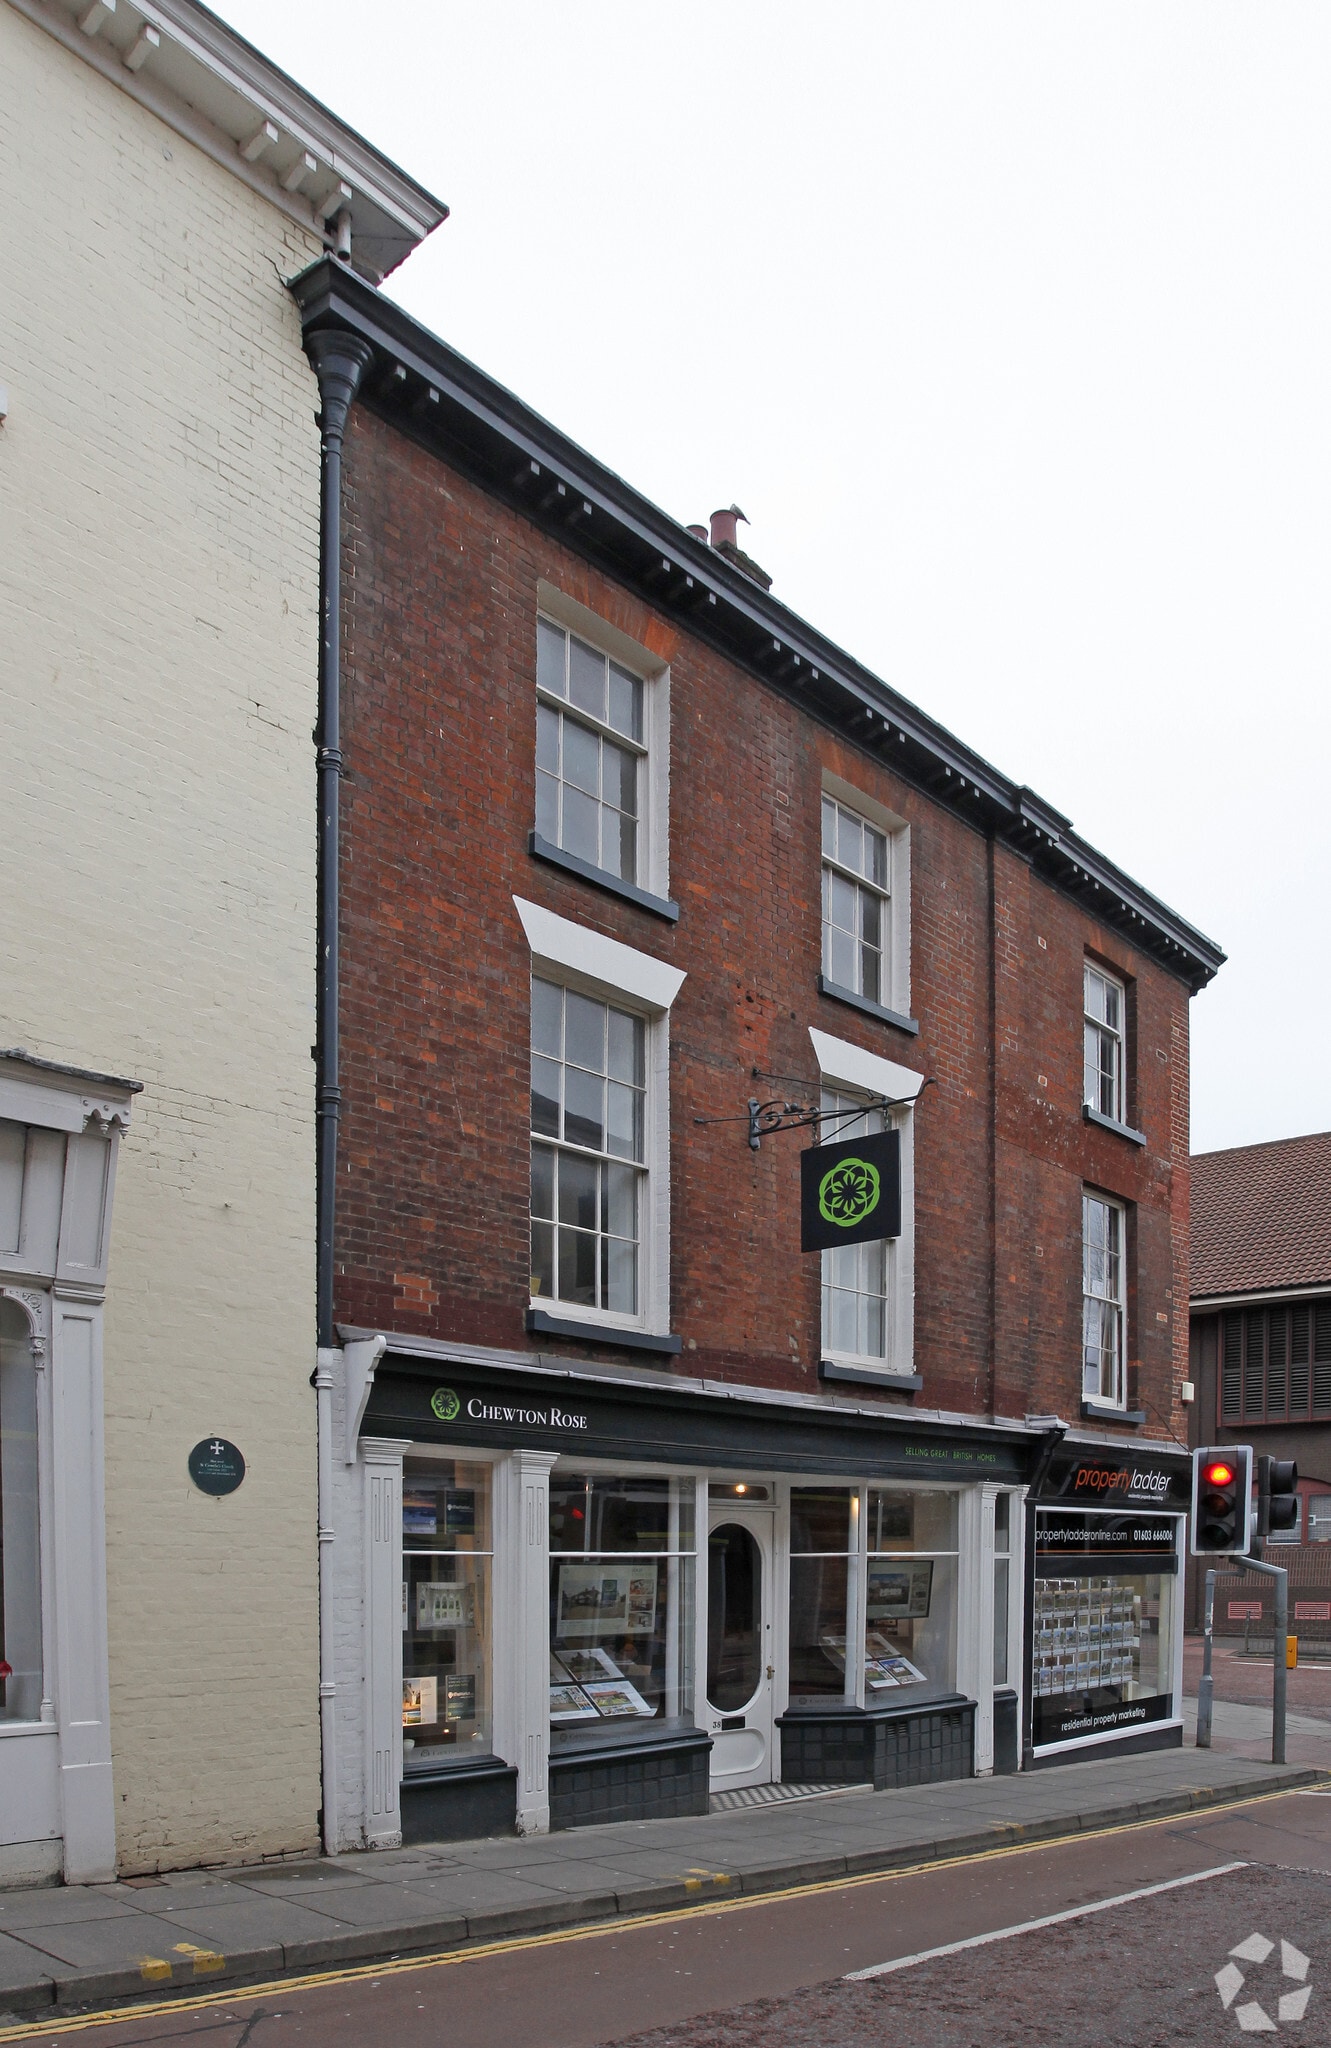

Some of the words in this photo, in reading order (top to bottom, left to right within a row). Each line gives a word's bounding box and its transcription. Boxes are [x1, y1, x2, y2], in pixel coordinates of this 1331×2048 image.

[467, 1398, 547, 1425] CHEWTON
[550, 1407, 588, 1429] ROSE
[905, 1447, 929, 1456] SELLING
[930, 1449, 948, 1458] GREAT
[953, 1451, 973, 1460] BRITISH
[977, 1454, 996, 1462] HOMES
[1035, 1529, 1128, 1542] propertyladderonline.com
[1133, 1530, 1152, 1541] 01603
[1153, 1530, 1173, 1541] 666006
[1061, 1716, 1093, 1731] residential
[1093, 1712, 1118, 1727] property
[1118, 1707, 1146, 1719] marketing
